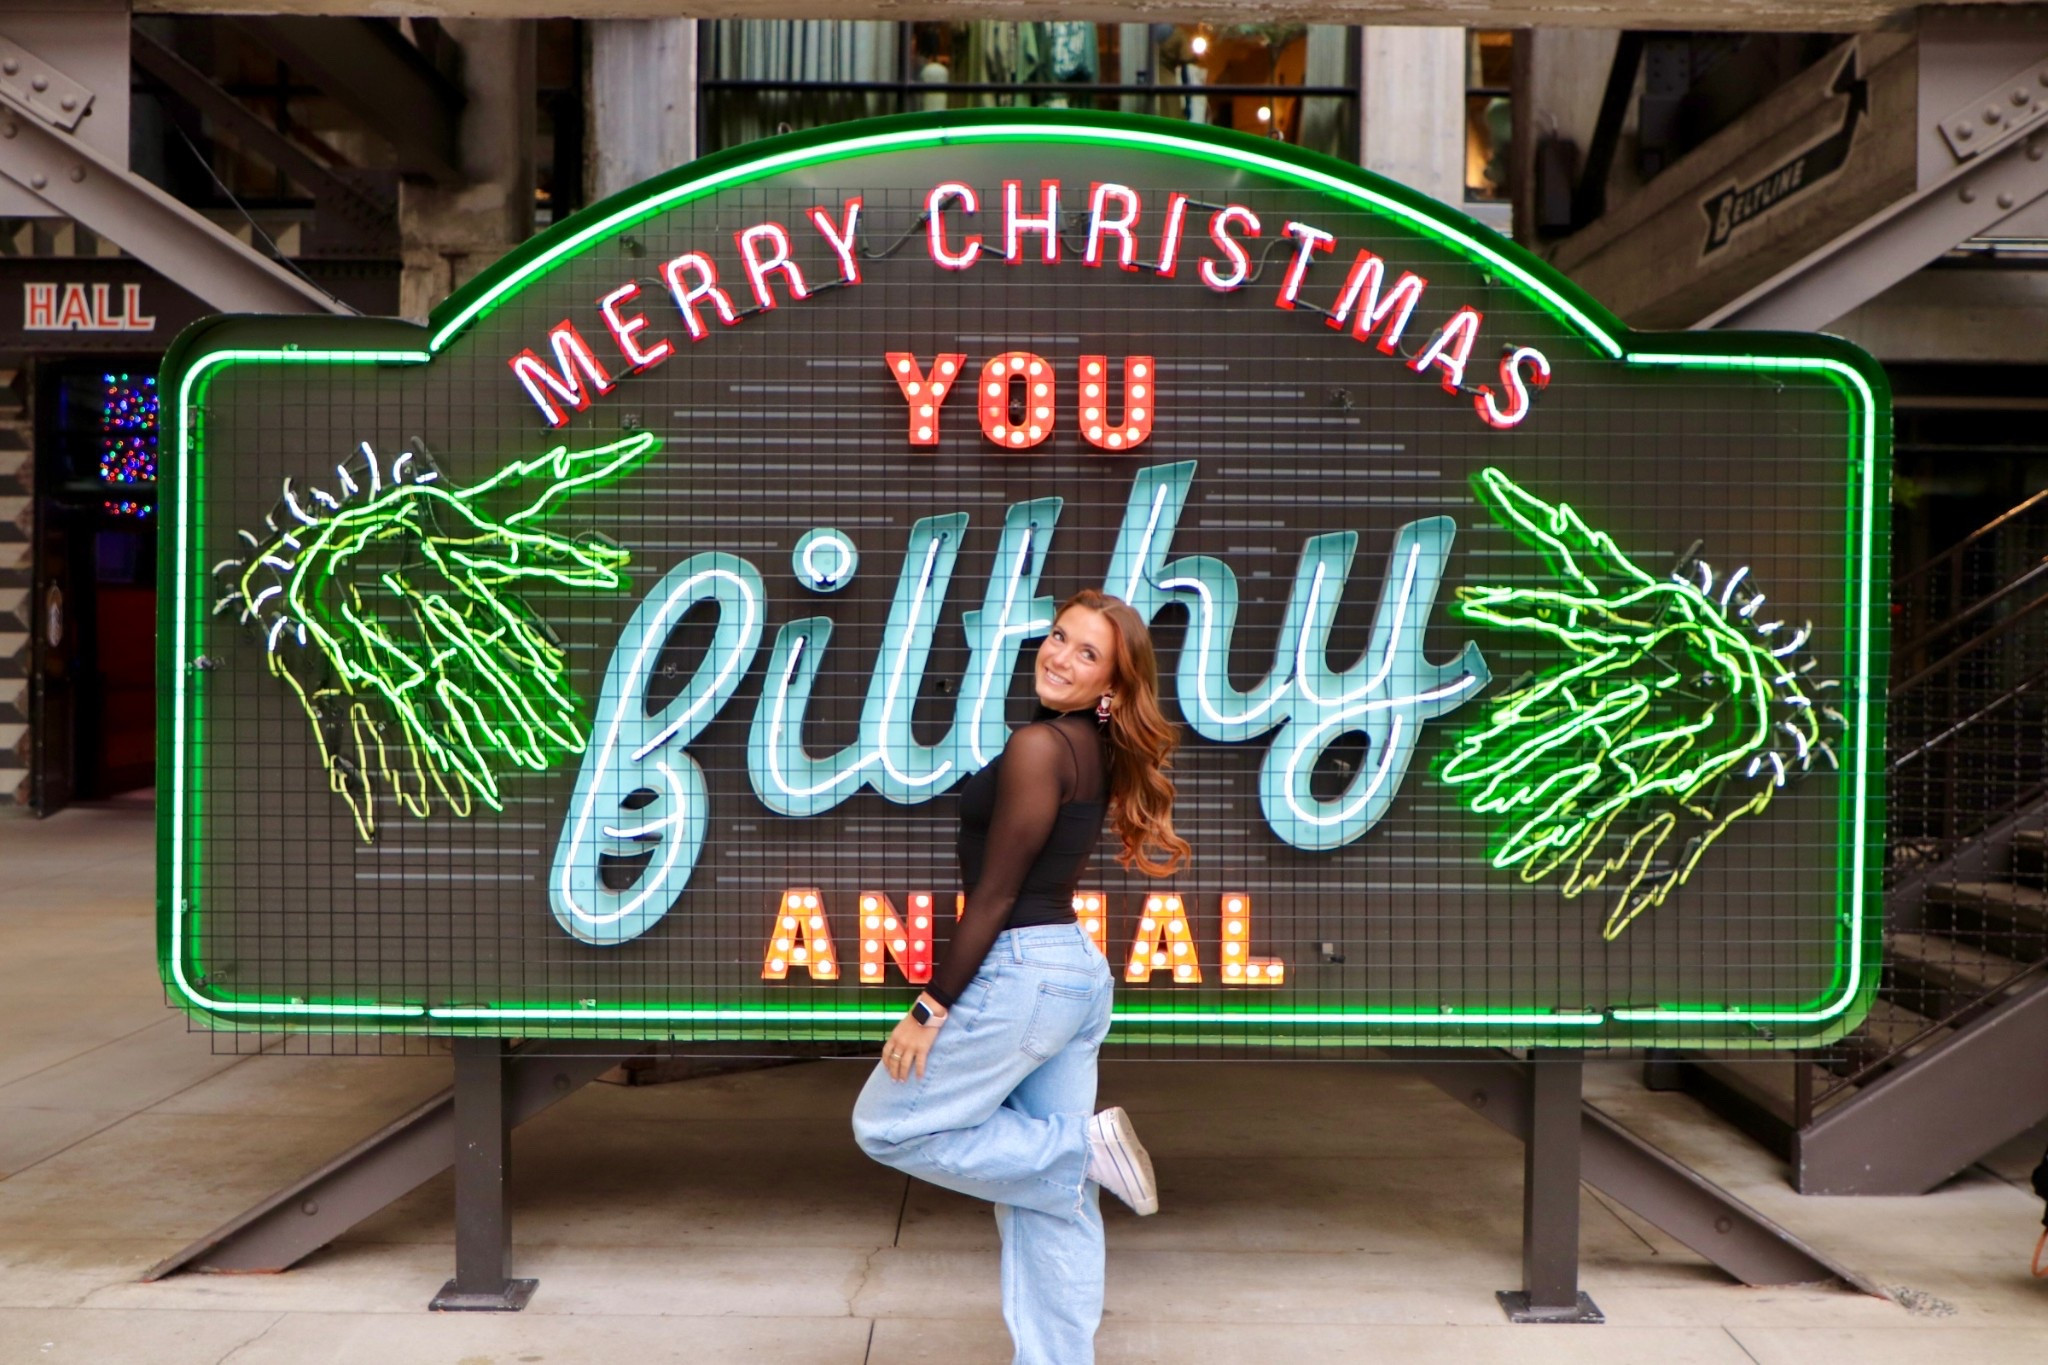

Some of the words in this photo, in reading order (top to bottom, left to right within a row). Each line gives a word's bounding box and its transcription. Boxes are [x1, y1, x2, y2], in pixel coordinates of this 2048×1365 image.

[24, 282, 156, 331] HALL
[508, 195, 864, 428] MERRY
[925, 178, 1552, 430] CHRISTMAS
[884, 350, 1155, 450] YOU
[762, 887, 1285, 986] ANAL
